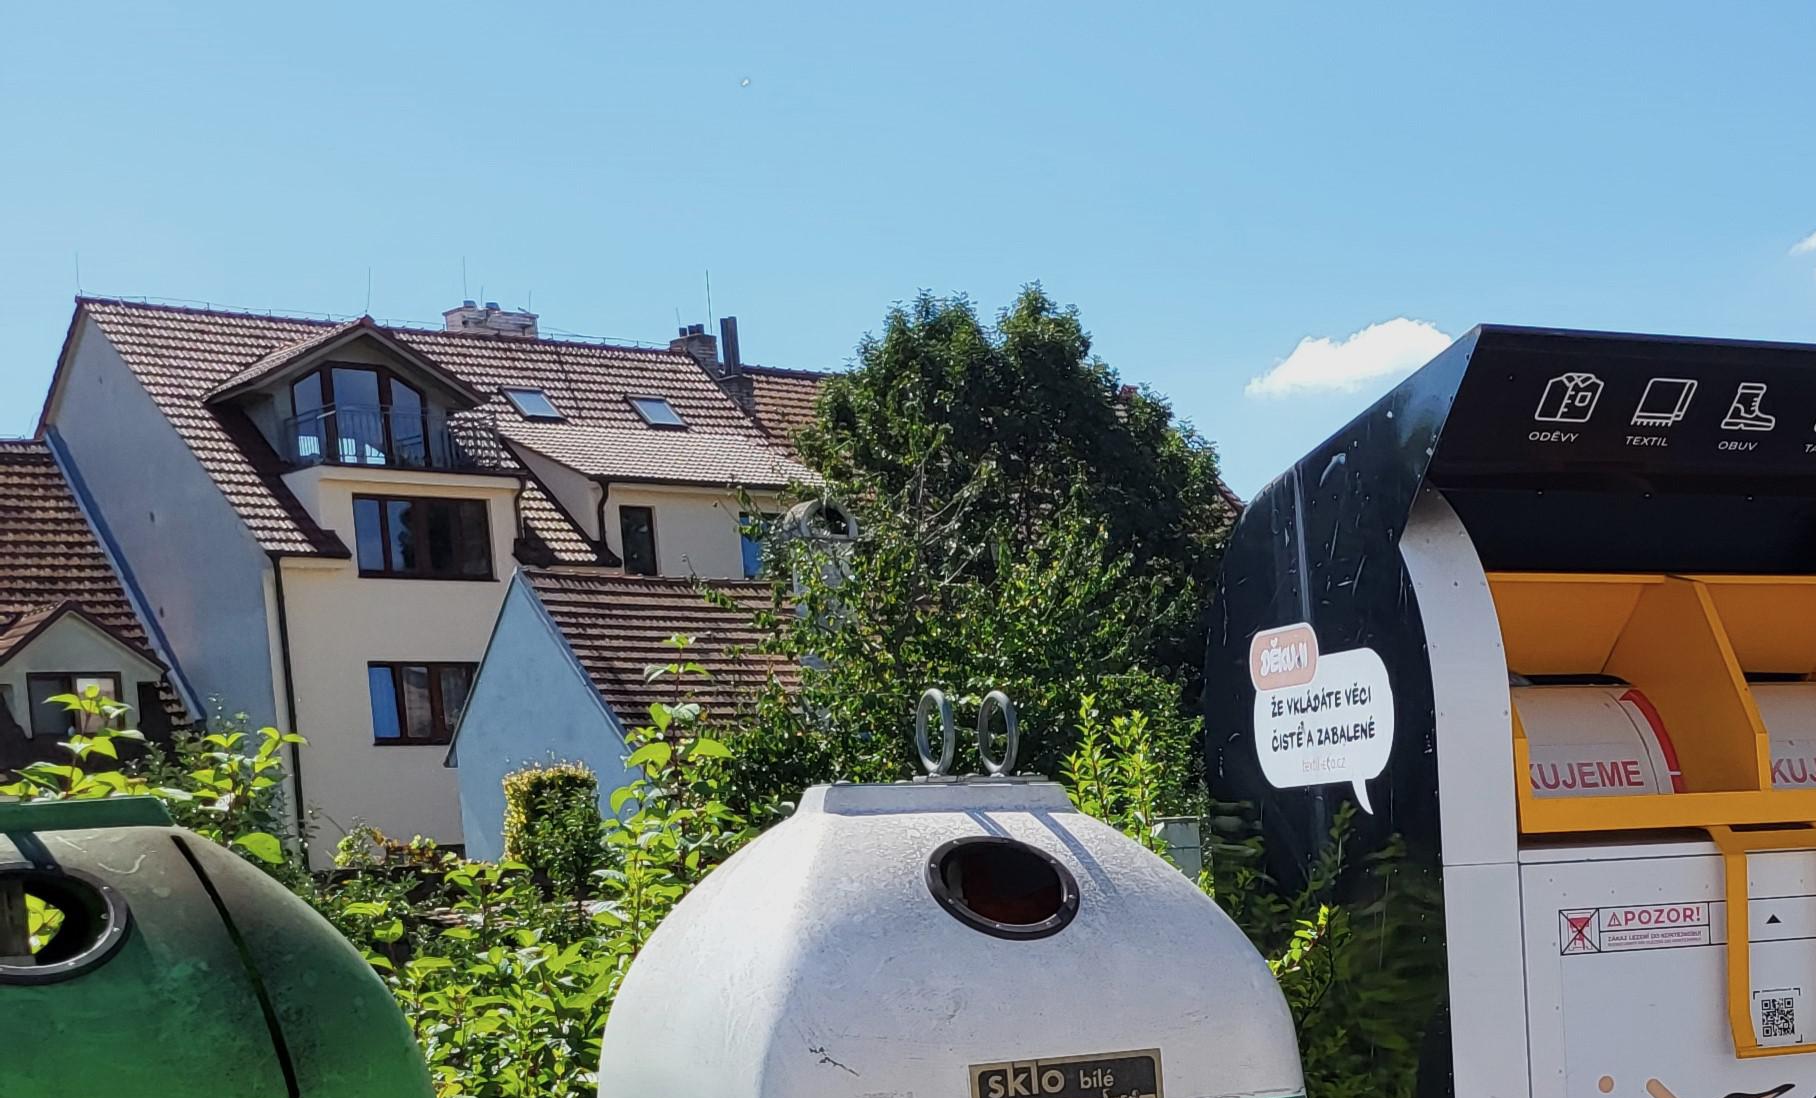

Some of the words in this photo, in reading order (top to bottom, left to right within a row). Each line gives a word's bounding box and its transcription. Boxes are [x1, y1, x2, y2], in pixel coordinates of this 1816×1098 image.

[1528, 429, 1580, 444] ODĚVY
[1625, 435, 1669, 448] TEXTIL
[1718, 440, 1759, 452] OBUV
[1271, 696, 1284, 718] ŽE
[1287, 687, 1341, 715] VKLÁDÁTE
[1345, 682, 1371, 706] VĚCI
[1271, 725, 1303, 752] ČISTÉ
[1307, 729, 1314, 748] A
[1317, 715, 1375, 746] ZABALENÉ
[1528, 759, 1645, 790] KUJEME
[1624, 907, 1701, 926] POZOR!
[988, 1059, 1065, 1098] sklo
[1080, 1068, 1114, 1089] bílé
